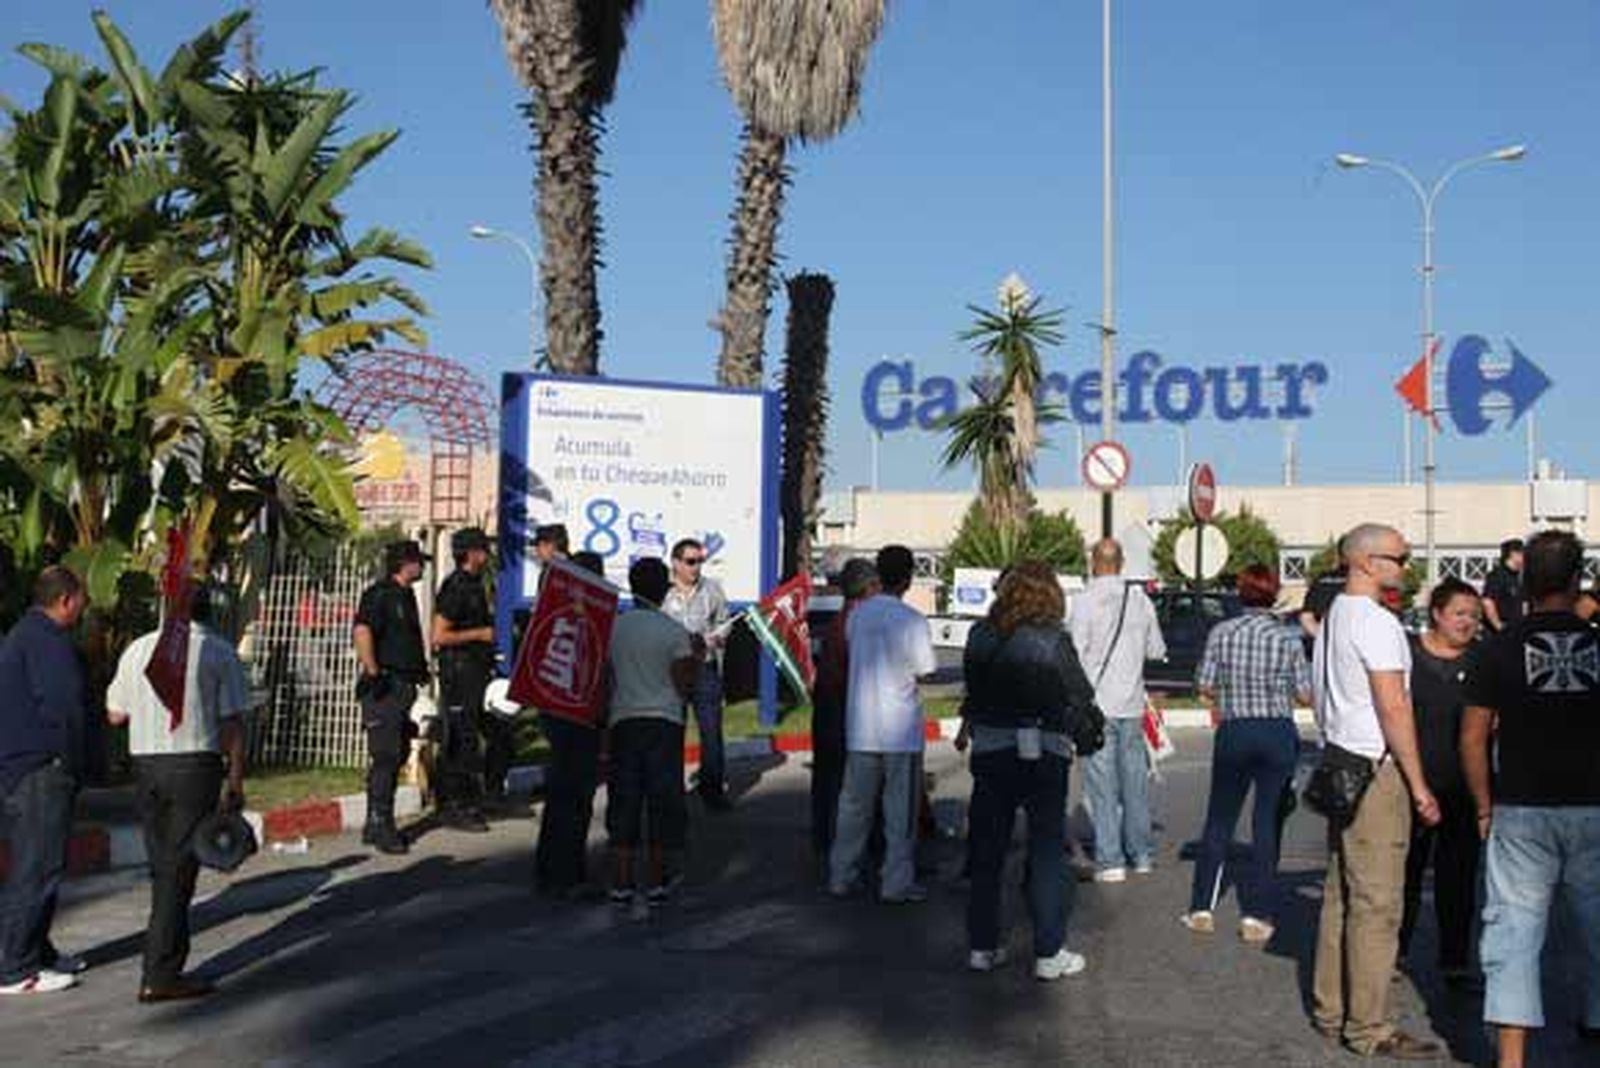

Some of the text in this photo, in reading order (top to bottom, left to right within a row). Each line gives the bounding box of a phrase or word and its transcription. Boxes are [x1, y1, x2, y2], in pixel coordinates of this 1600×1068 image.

[861, 351, 1328, 432] Carefour
[553, 436, 632, 457] Acumula
[584, 499, 620, 557] 8
[538, 617, 577, 690] UGT
